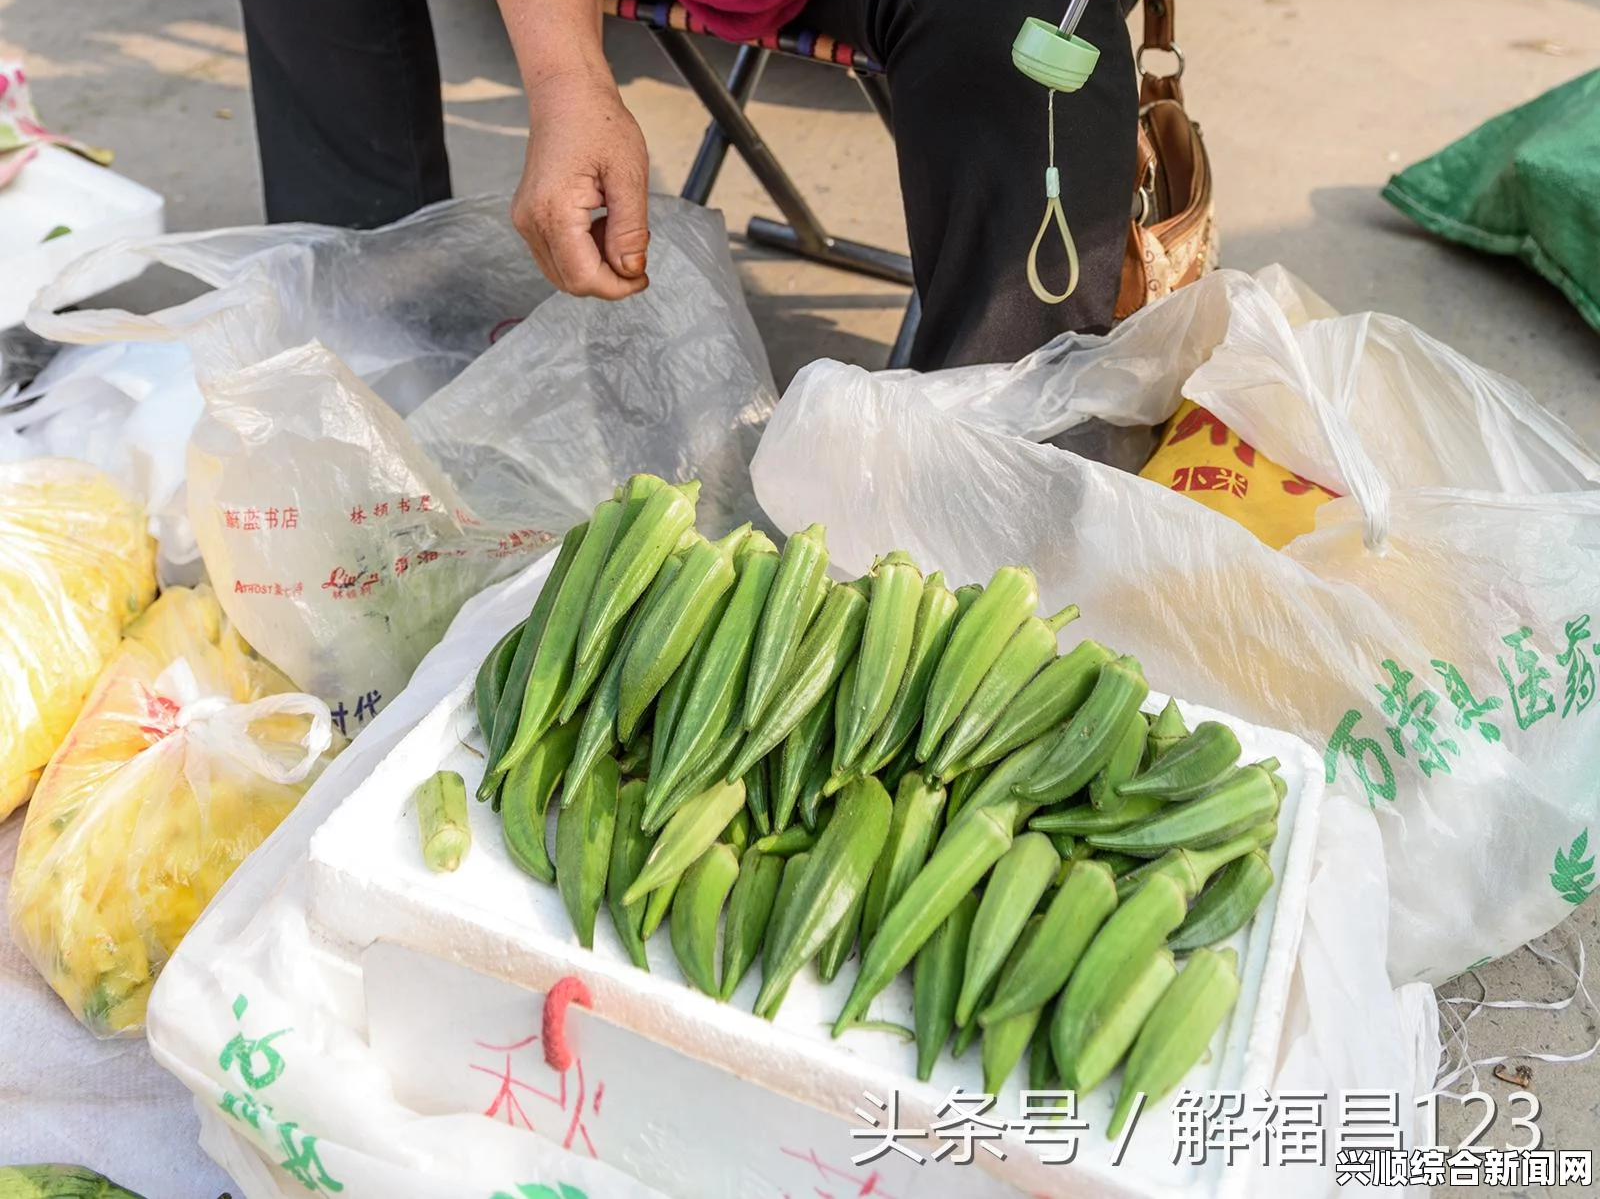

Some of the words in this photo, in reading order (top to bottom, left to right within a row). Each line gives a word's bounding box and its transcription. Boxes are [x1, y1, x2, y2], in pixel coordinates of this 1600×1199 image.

[1324, 614, 1600, 810] 万荣县医药
